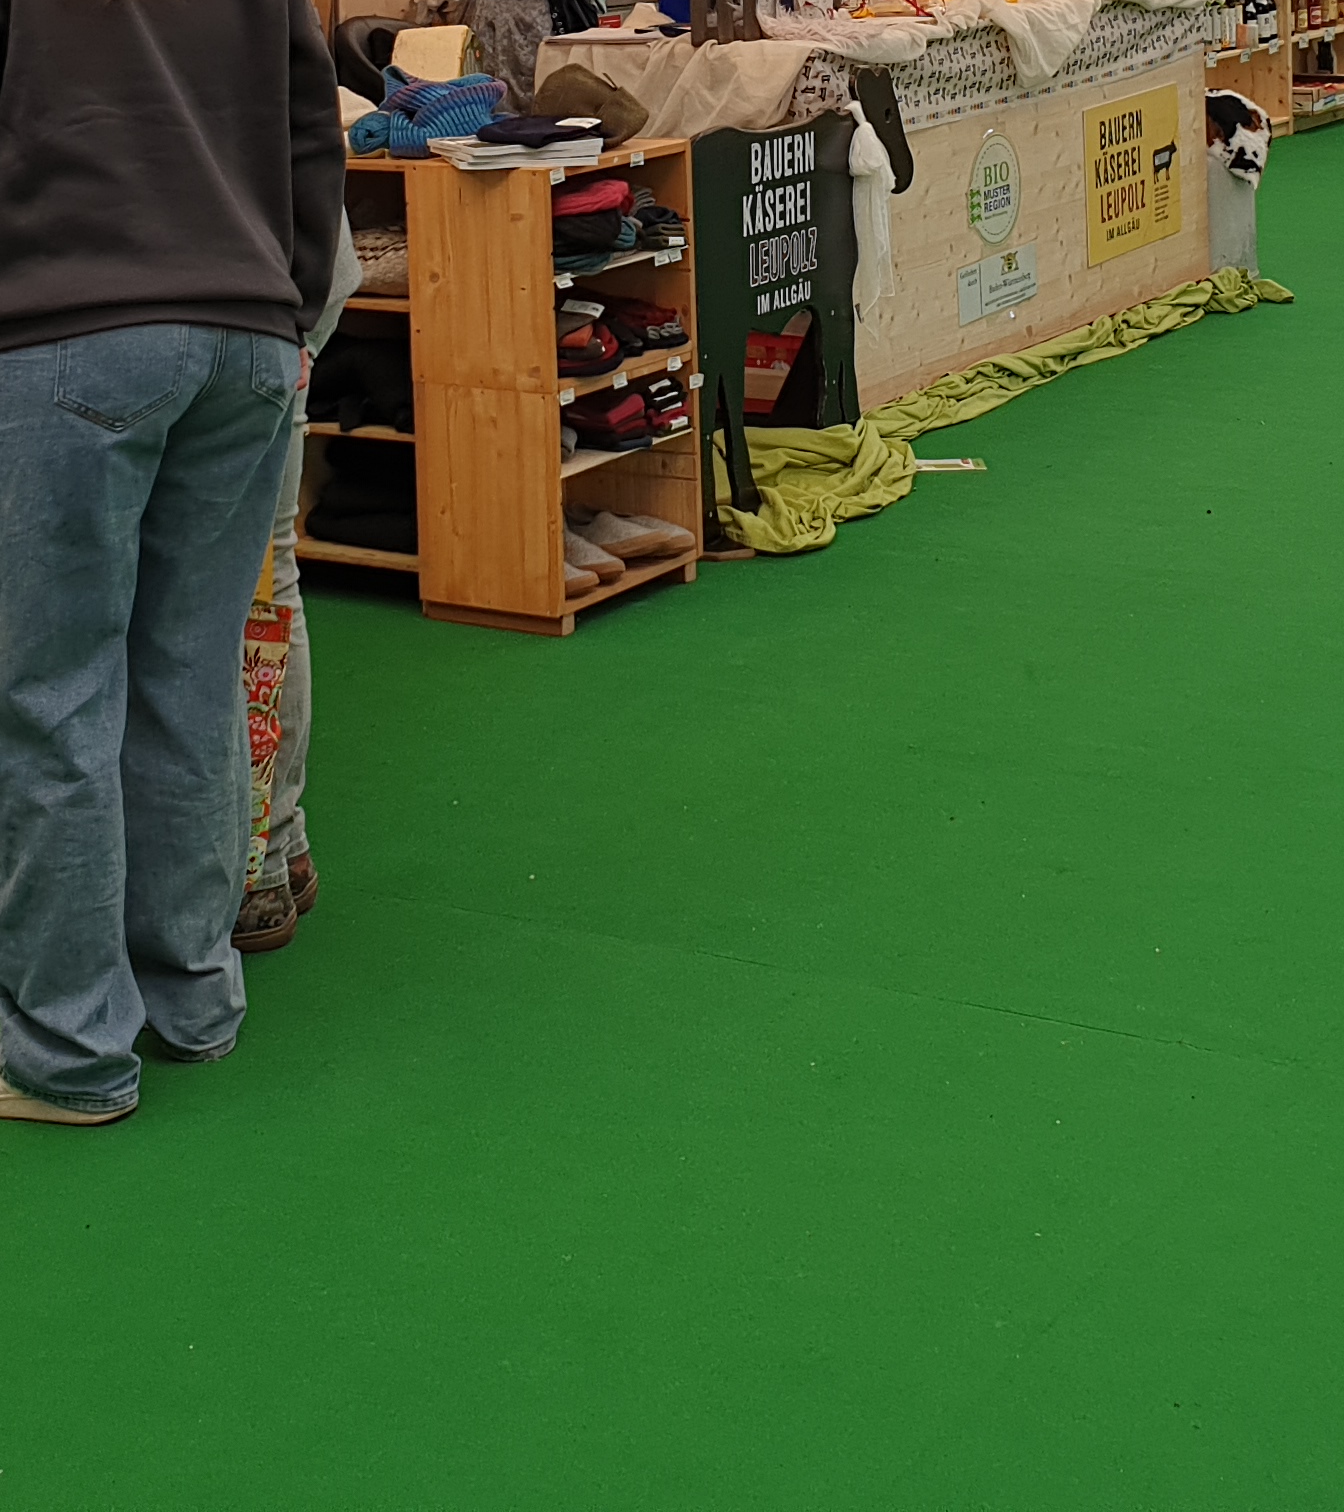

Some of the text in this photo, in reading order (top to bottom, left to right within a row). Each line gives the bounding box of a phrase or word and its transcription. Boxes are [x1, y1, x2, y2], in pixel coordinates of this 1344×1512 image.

[1099, 108, 1143, 151] BAUERN
[751, 131, 815, 185] BAUERN
[983, 161, 1010, 188] BIO
[1094, 145, 1142, 189] KÄSEREI
[742, 180, 811, 238] KÄSEREI
[983, 184, 1011, 201] MUSTER
[983, 196, 1011, 214] REGION
[1100, 179, 1146, 224] LEUPOLZ
[1106, 217, 1141, 242] IM ALLGÄU
[749, 226, 818, 288] LEUPOLZ
[757, 278, 811, 316] IM ALLGÄU
